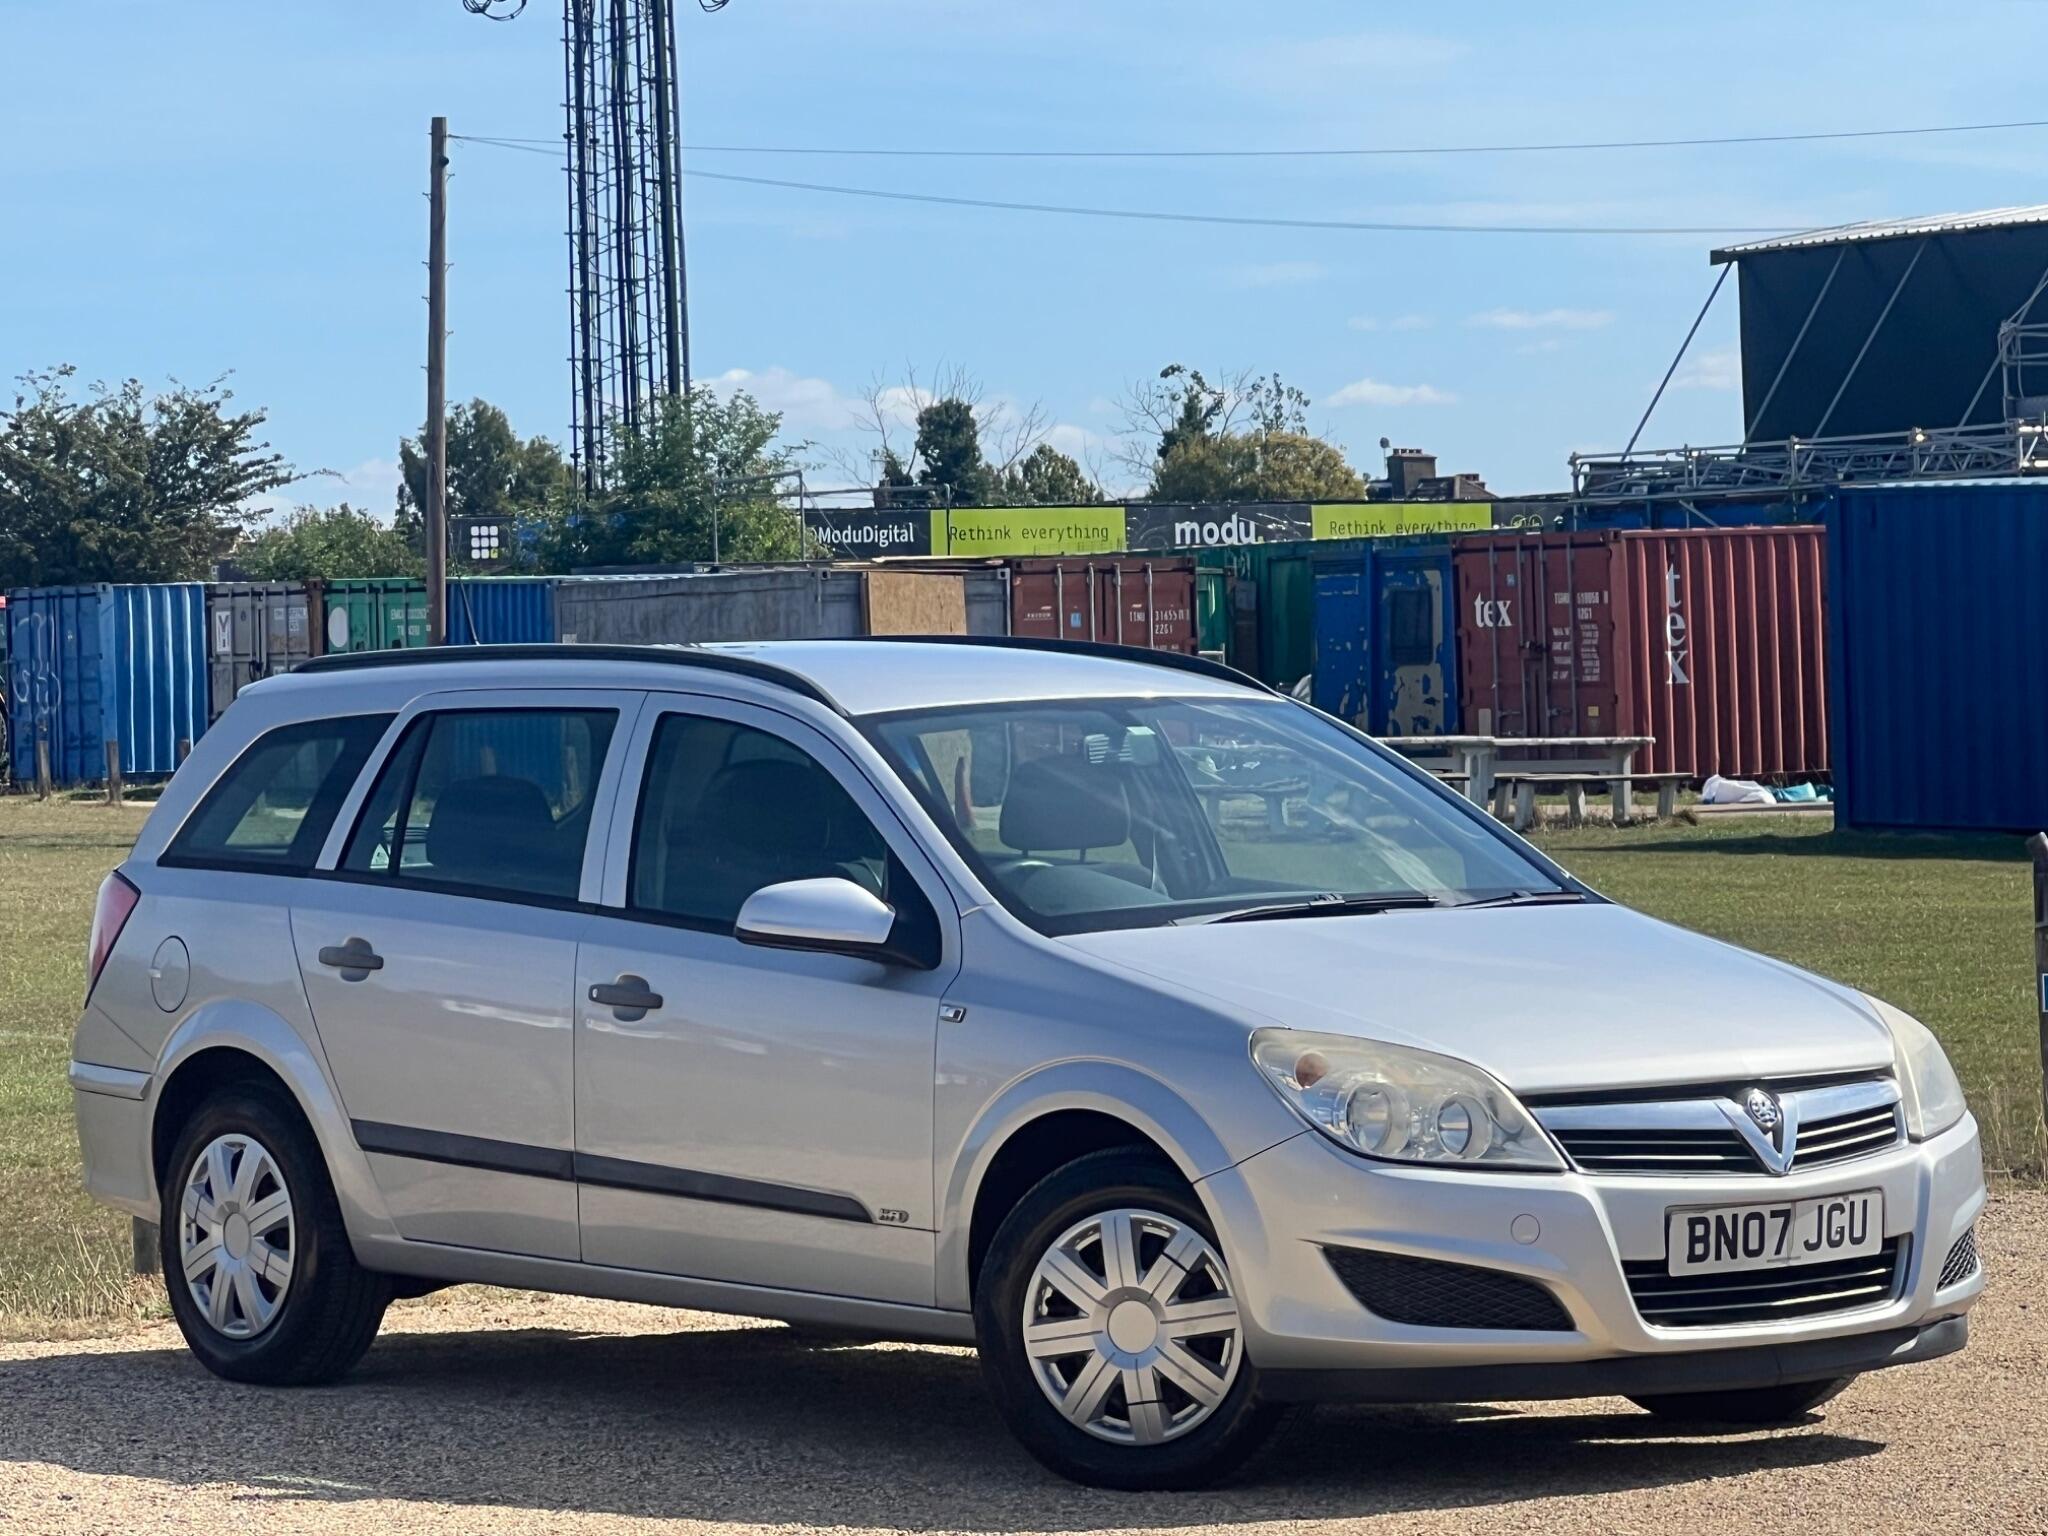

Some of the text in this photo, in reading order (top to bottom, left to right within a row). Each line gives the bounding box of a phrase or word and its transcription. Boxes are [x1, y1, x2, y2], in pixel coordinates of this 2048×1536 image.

[949, 524, 1109, 543] Rethink everything
[1329, 519, 1388, 536] Rethink
[1474, 591, 1512, 628] tex
[1665, 562, 1690, 684] tex
[1686, 1198, 1868, 1264] BN07 JGU
